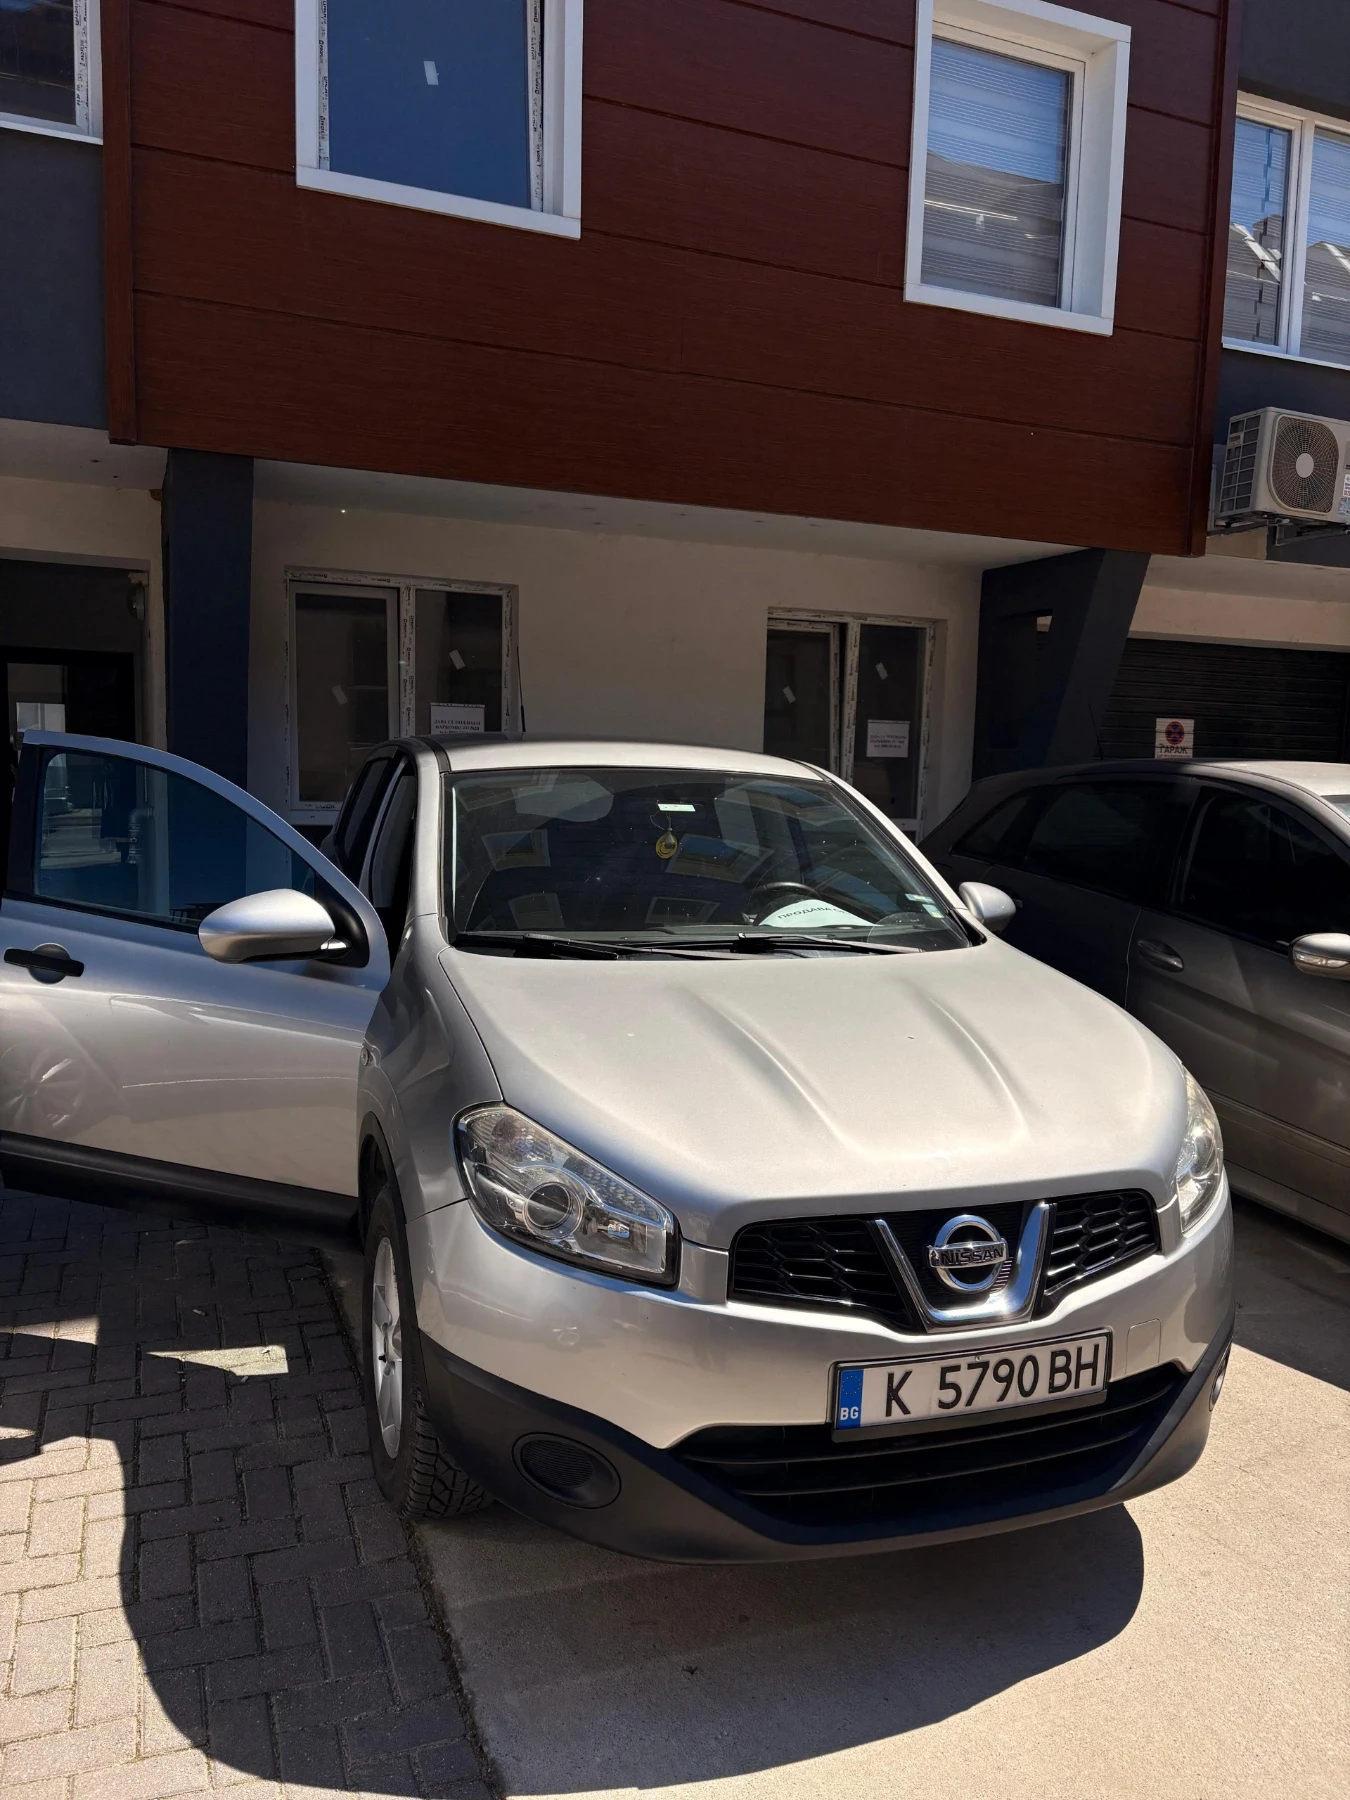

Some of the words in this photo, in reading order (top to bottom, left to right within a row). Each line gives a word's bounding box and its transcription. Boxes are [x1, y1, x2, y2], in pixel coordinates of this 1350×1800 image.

[1159, 745, 1188, 753] ГАРАЖ
[777, 907, 833, 919] ПРОДАВА
[941, 1247, 1004, 1265] NISSAN
[885, 1370, 913, 1417] K
[938, 1354, 1040, 1410] 5790
[1049, 1344, 1101, 1394] BH
[840, 1406, 859, 1421] BG
